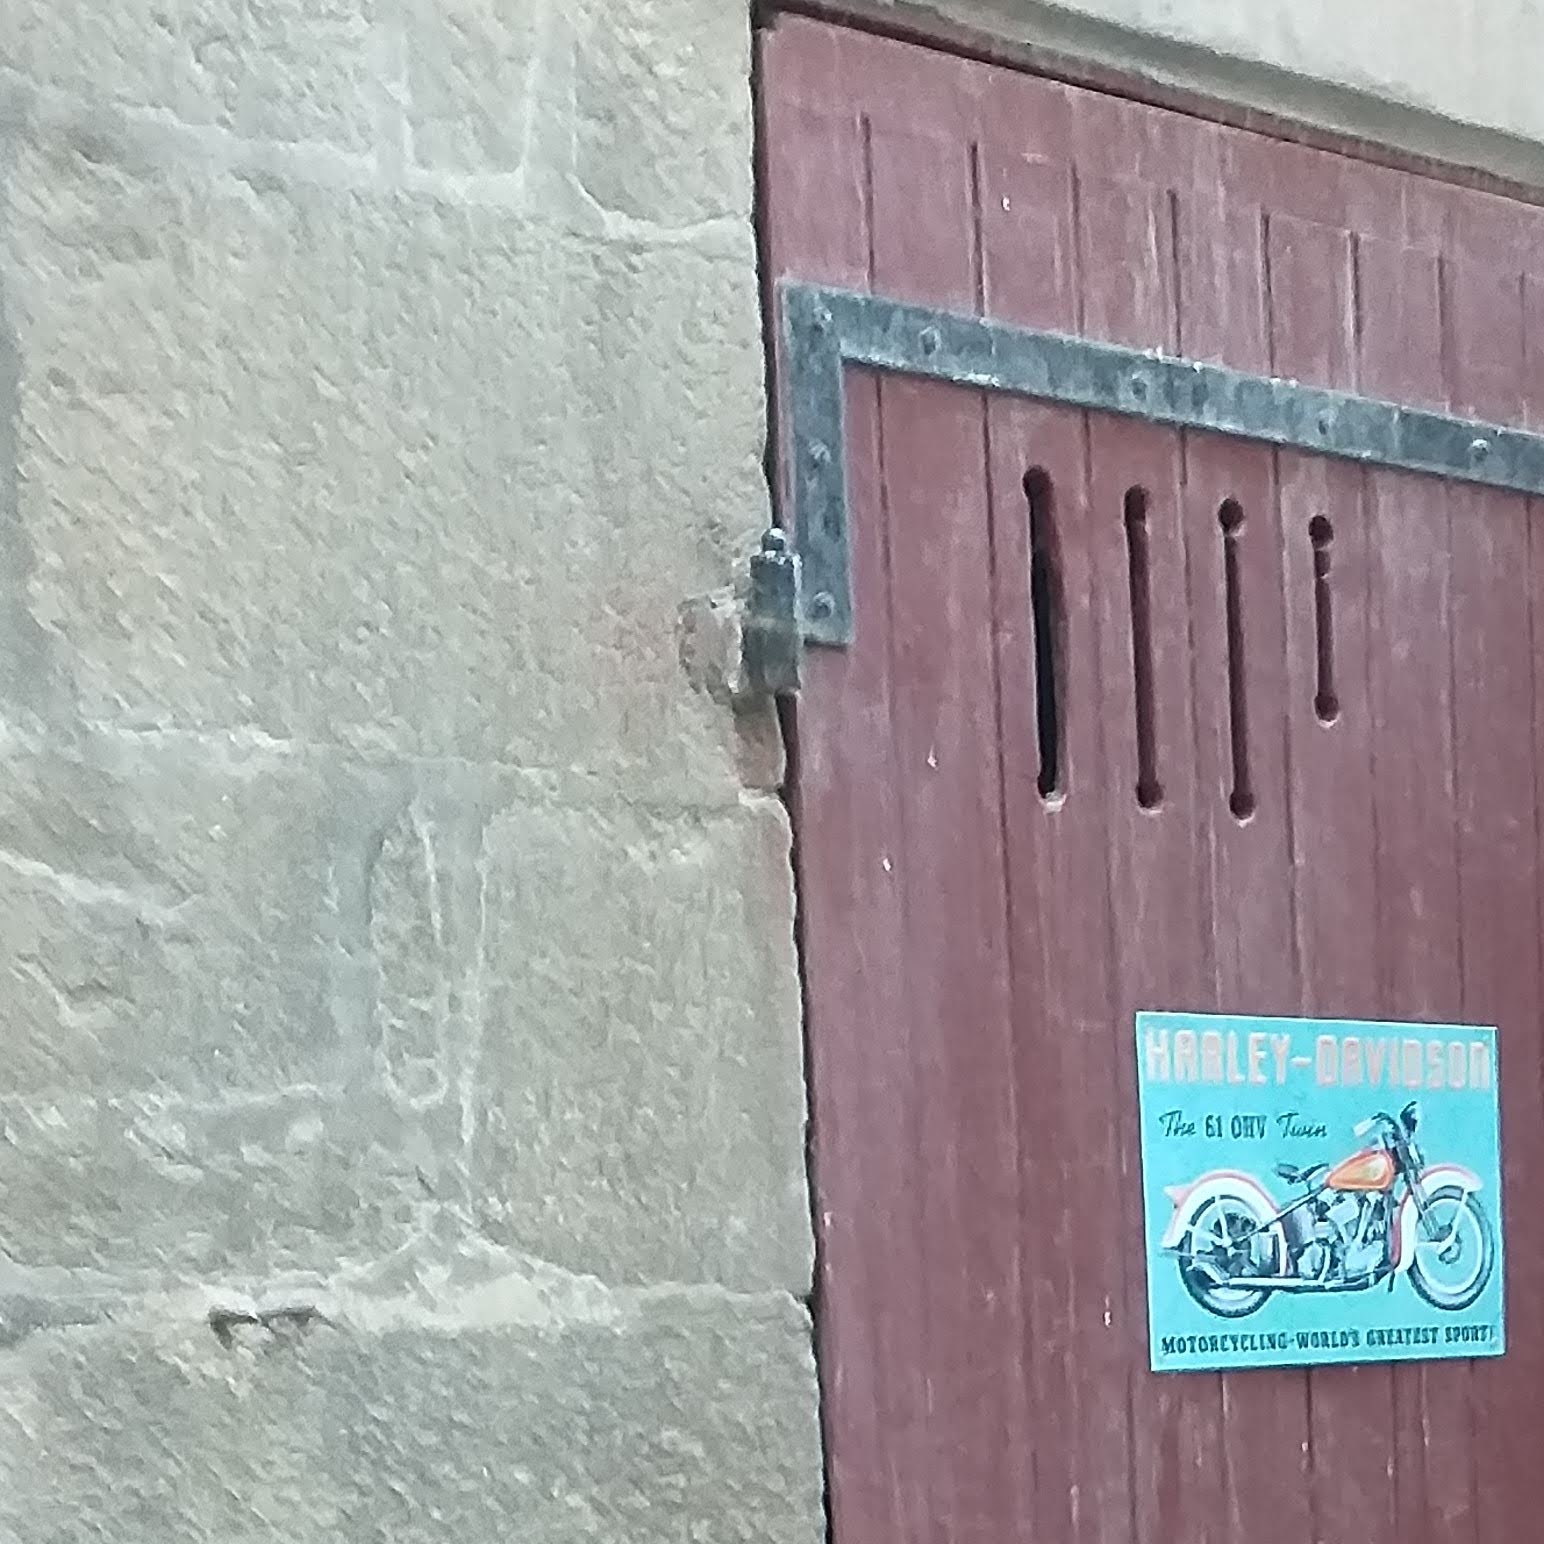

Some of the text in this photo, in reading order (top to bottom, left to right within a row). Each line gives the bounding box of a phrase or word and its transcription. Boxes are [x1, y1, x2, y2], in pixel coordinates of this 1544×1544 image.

[1145, 1027, 1491, 1090] HARLEY-DAVIDSON
[1159, 1110, 1328, 1139] The 61 OHV Twin
[1366, 1327, 1440, 1346] GREATEST
